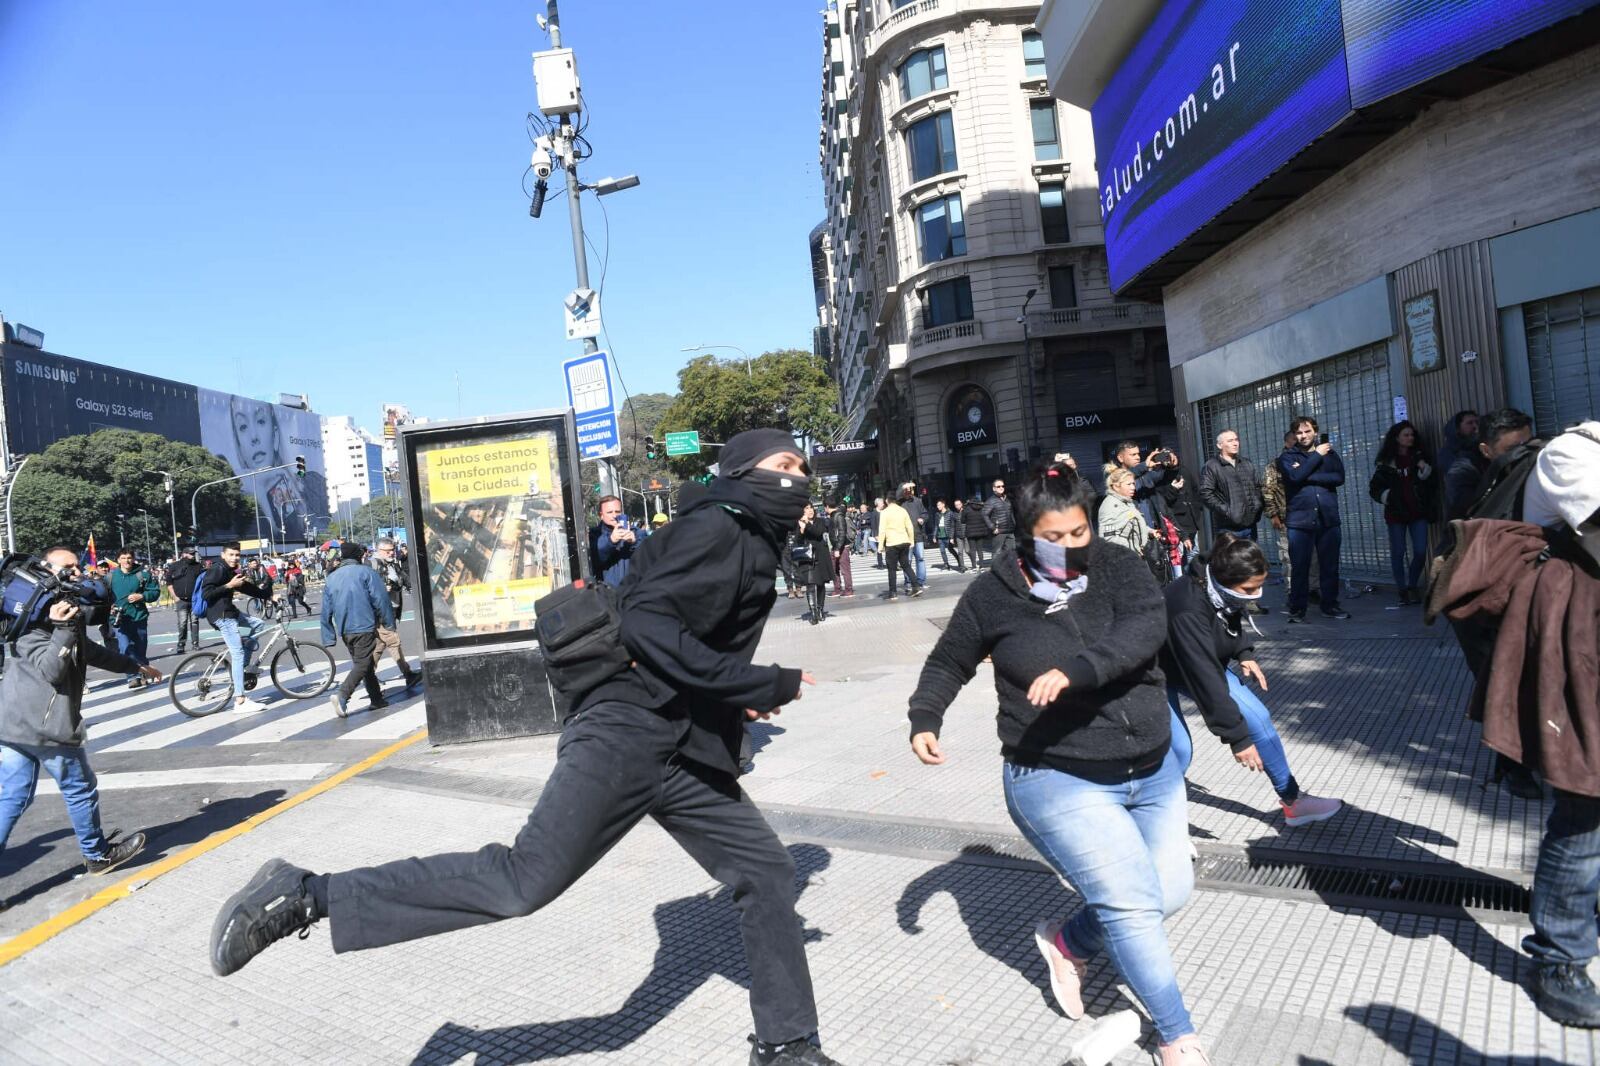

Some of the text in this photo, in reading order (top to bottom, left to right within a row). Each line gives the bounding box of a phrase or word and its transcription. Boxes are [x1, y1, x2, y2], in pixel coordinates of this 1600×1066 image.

[15, 359, 77, 384] SAMSUNG
[75, 397, 154, 421] Galaxy S23 Series
[1065, 413, 1102, 428] BBVA
[289, 435, 307, 448] Galaxy
[957, 427, 987, 443] BBVA
[436, 447, 539, 468] Juntos estamos
[440, 461, 538, 481] transformando
[458, 476, 524, 494] la Ciudad.
